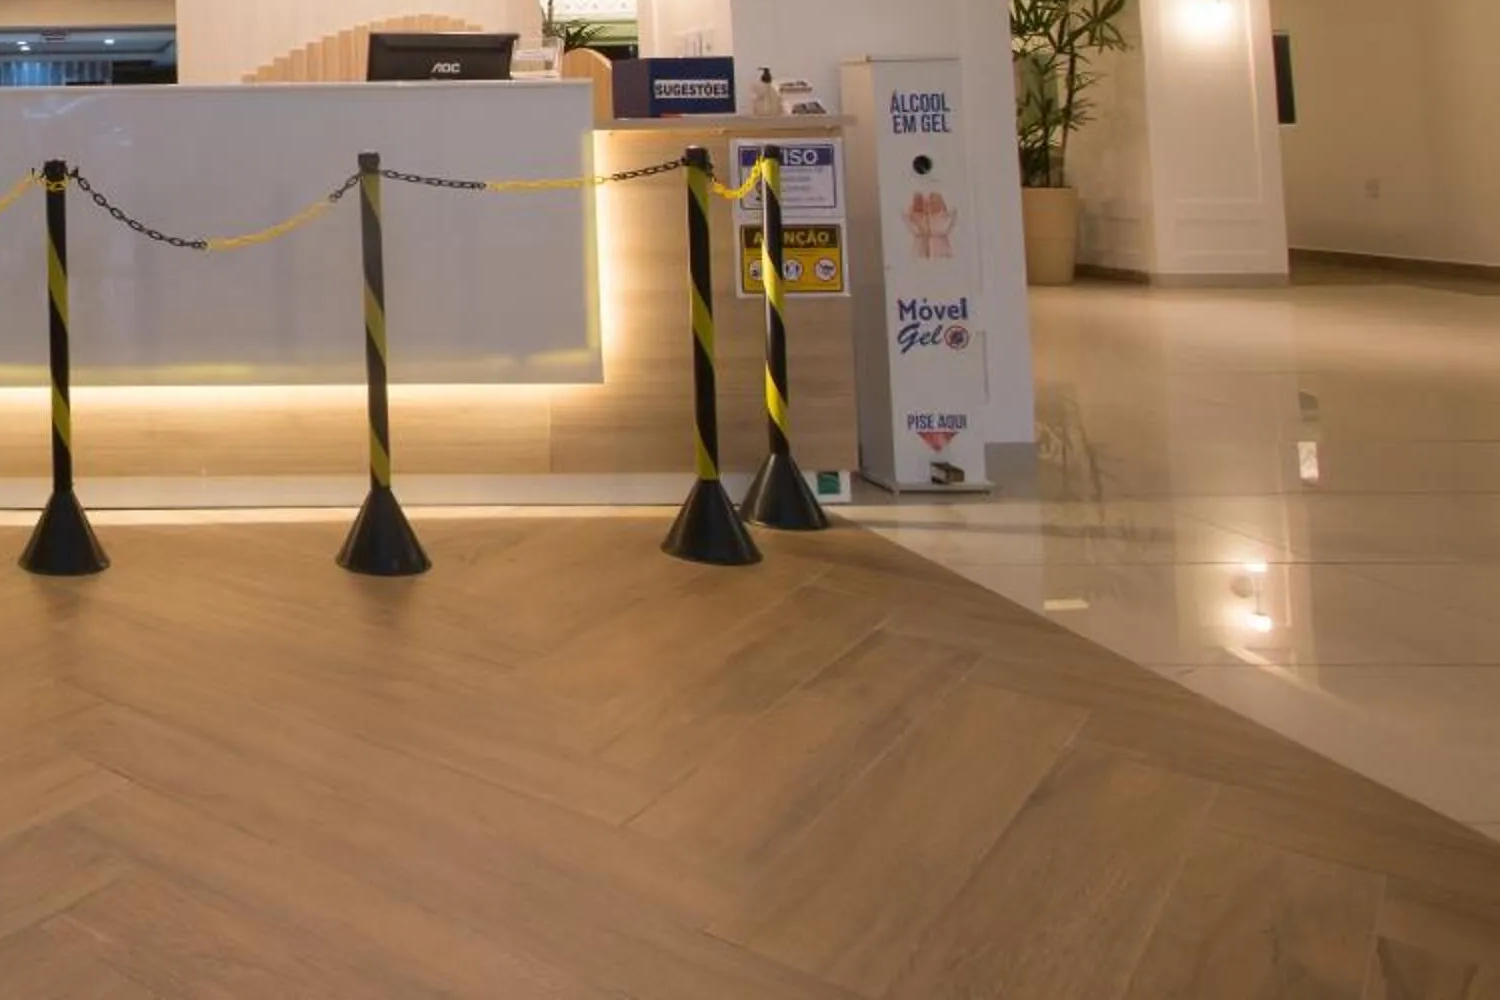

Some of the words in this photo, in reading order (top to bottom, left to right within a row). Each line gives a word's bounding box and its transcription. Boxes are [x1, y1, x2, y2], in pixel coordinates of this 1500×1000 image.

[431, 62, 461, 74] AOC
[654, 81, 728, 97] SUGESTÕES
[890, 90, 951, 114] ÁLCOOL
[893, 115, 917, 134] EM
[921, 113, 951, 133] GEL
[764, 149, 818, 166] ISO
[753, 228, 829, 248] ANÇÃO
[897, 297, 967, 321] Móvel
[897, 322, 943, 354] Gel
[907, 413, 933, 430] PISE
[938, 413, 967, 429] AQUI
